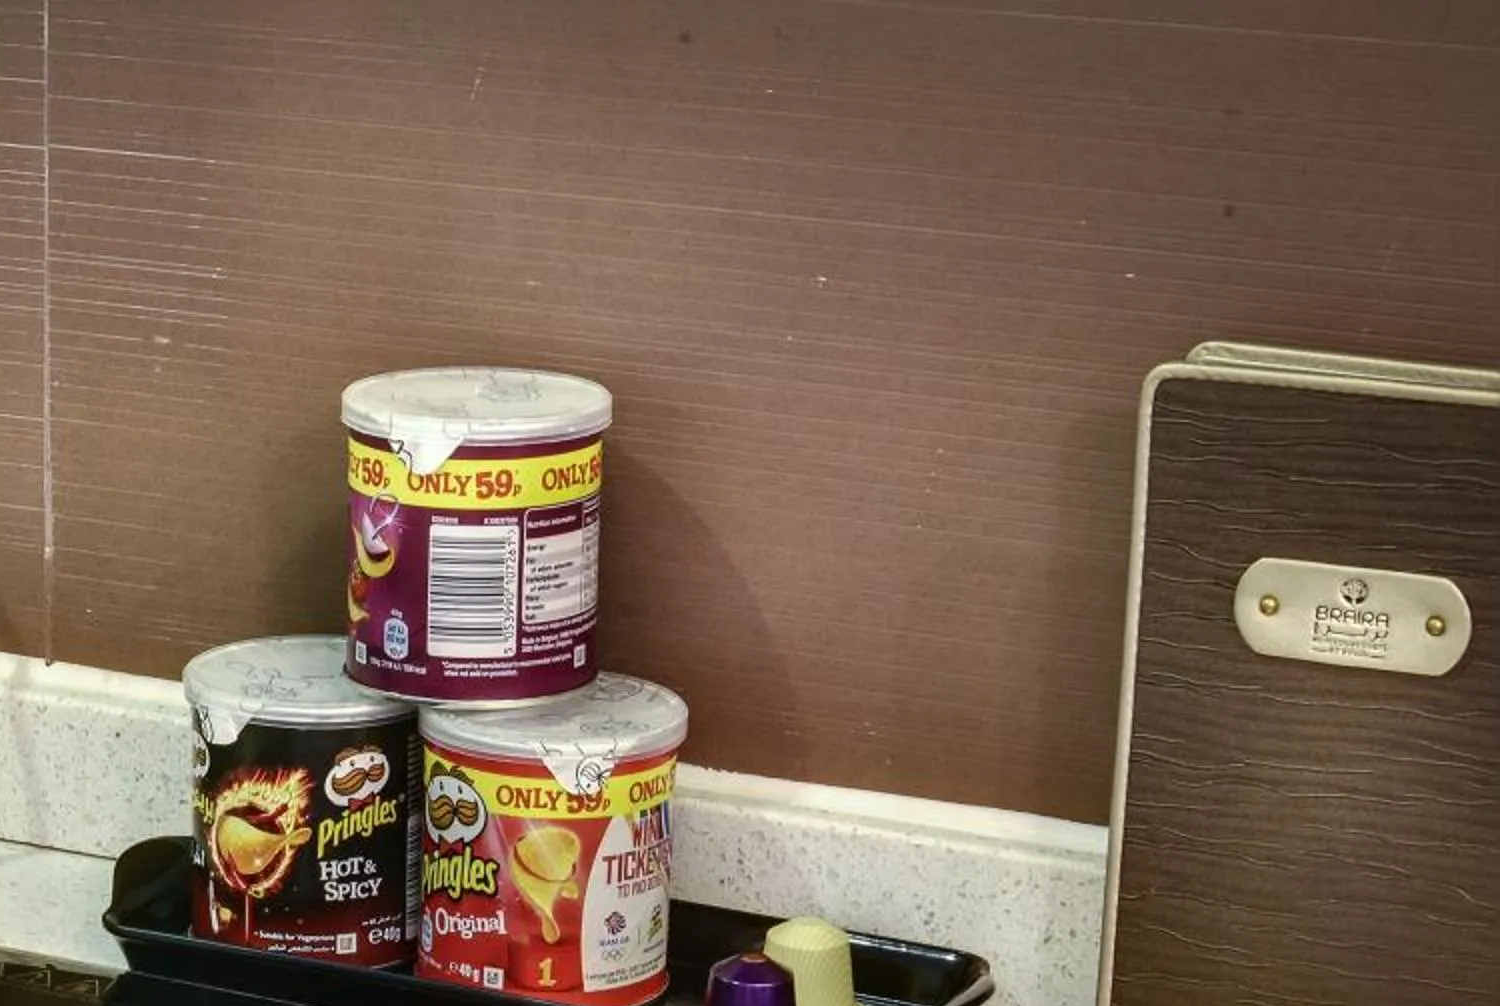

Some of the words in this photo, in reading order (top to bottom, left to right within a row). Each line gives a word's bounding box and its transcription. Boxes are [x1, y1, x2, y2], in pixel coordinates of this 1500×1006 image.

[407, 472, 472, 497] ONLY
[542, 462, 588, 492] ONLY
[1315, 605, 1389, 629] BRAIRA
[496, 784, 564, 812] ONLY
[317, 796, 396, 859] Pringles
[320, 856, 363, 881] HOT
[363, 859, 377, 875] &
[324, 877, 383, 901] SPICY
[435, 907, 507, 939] Original
